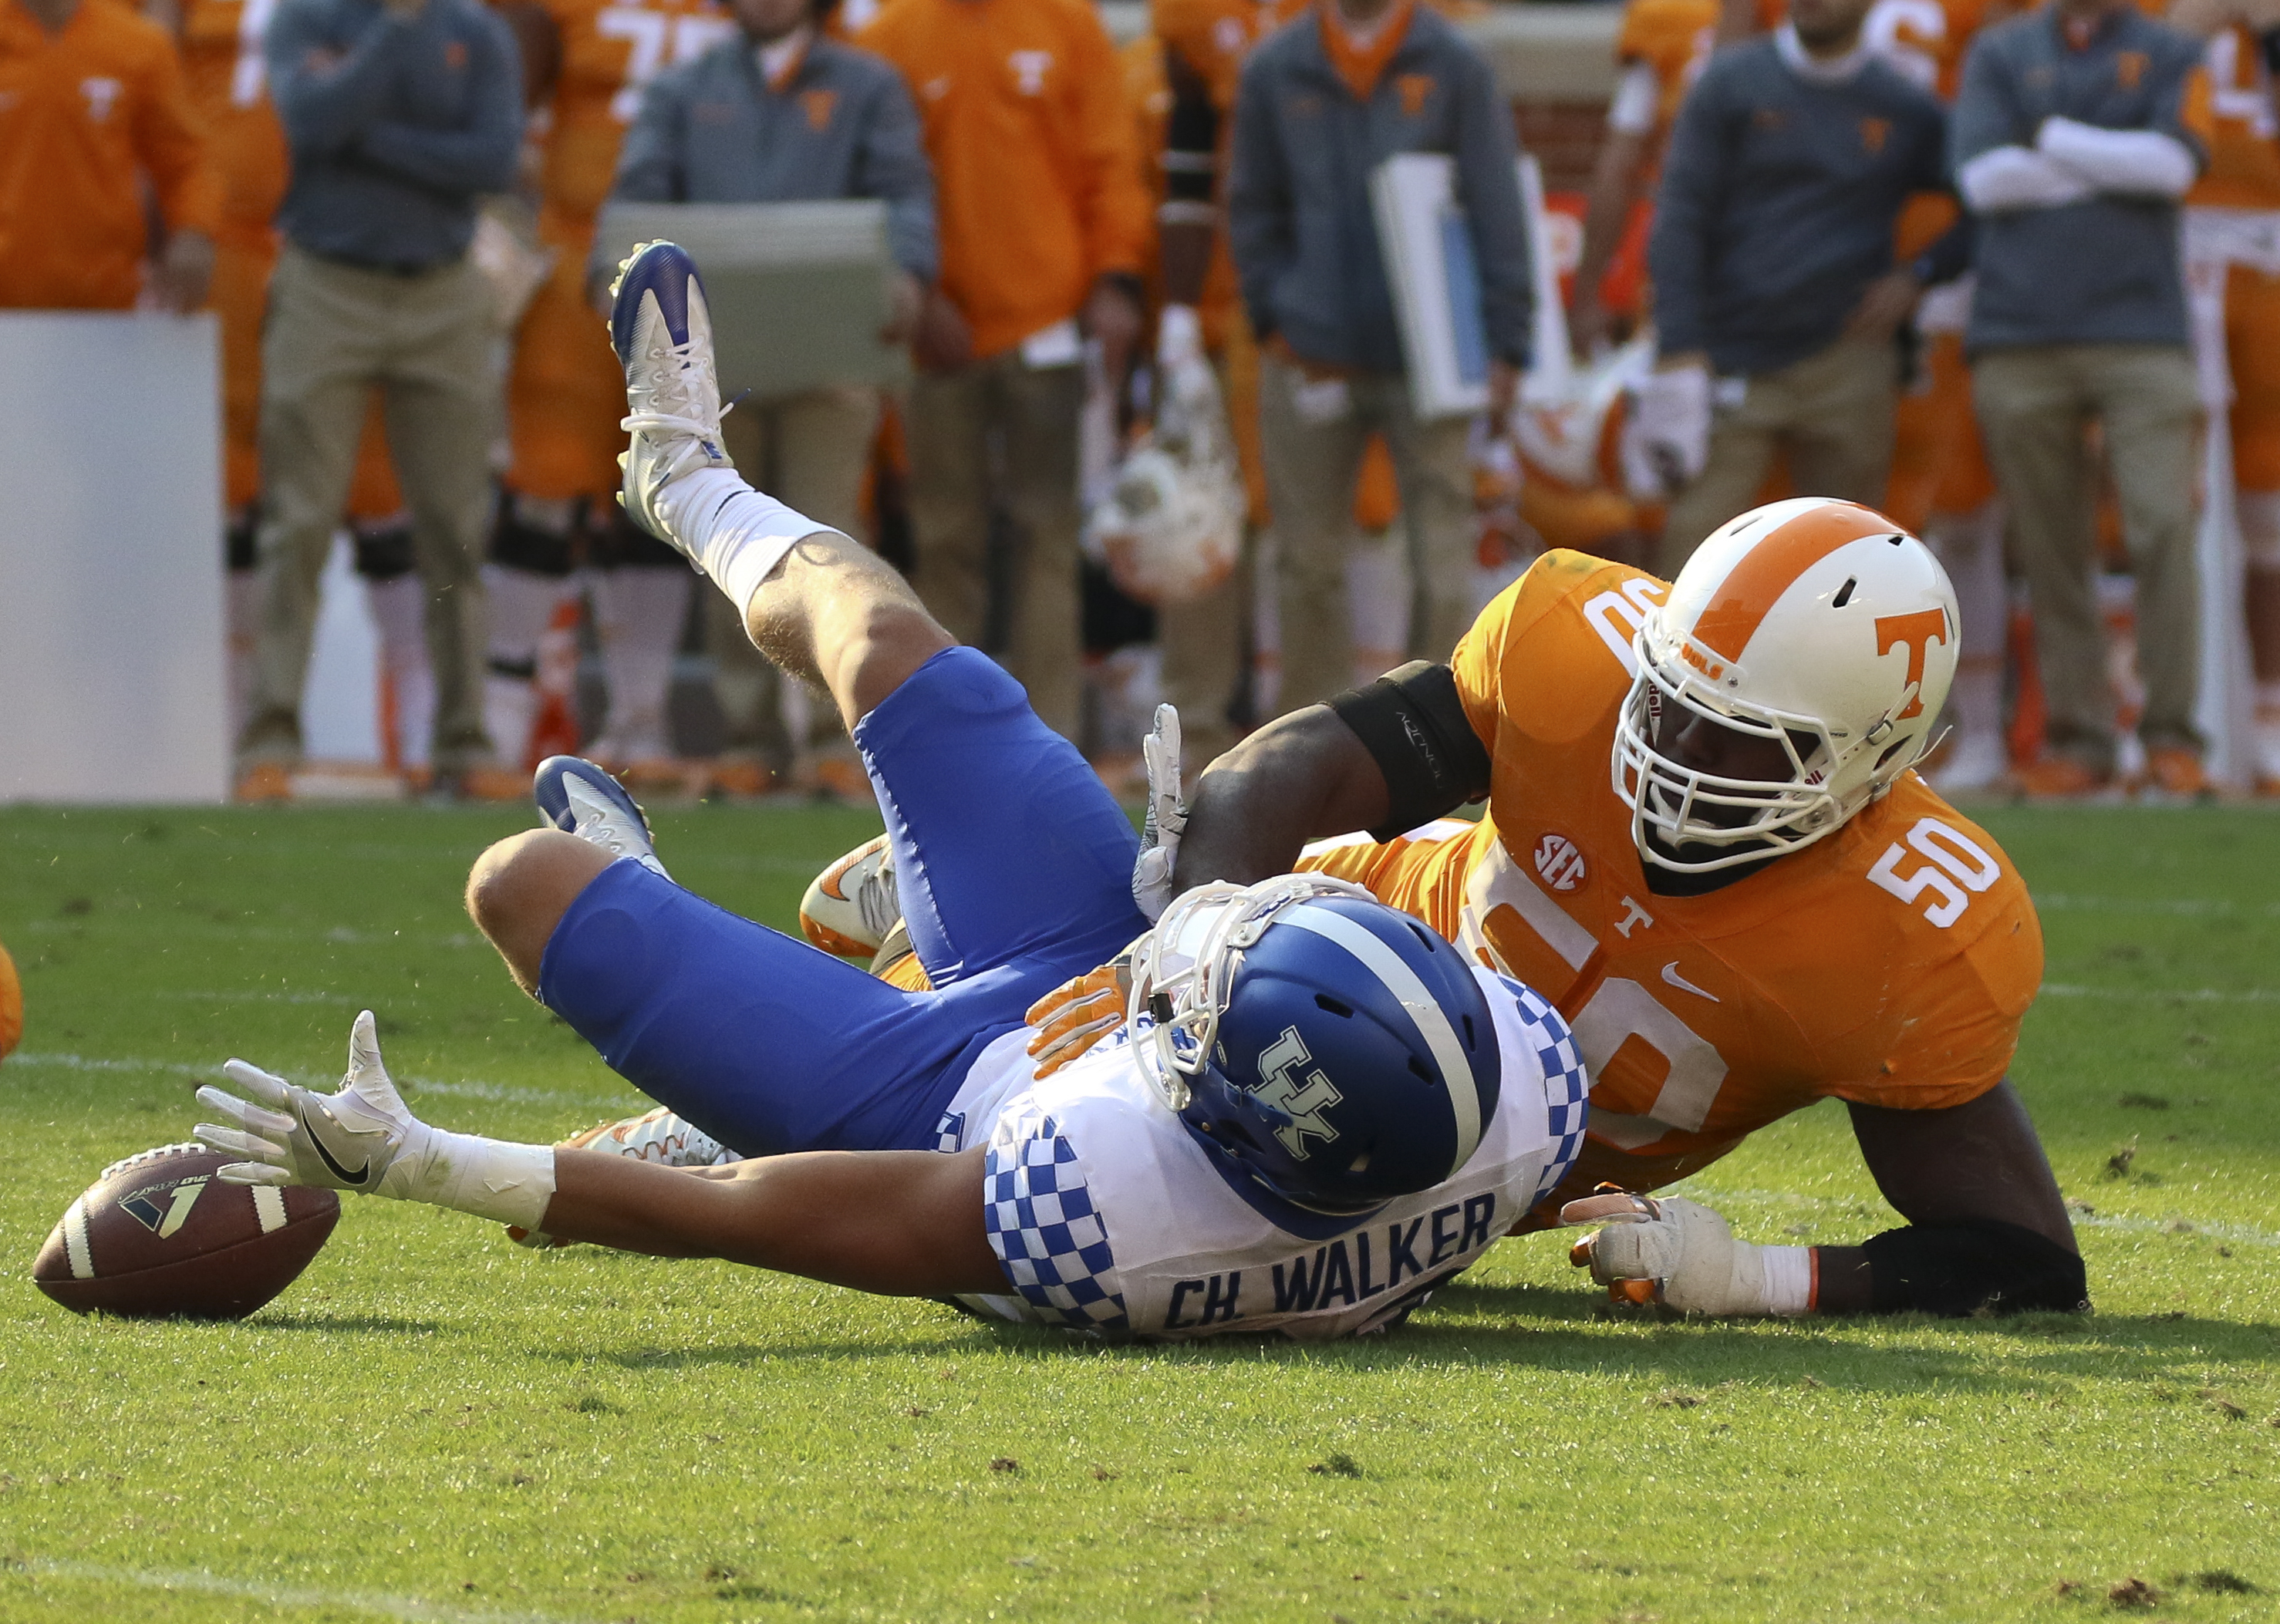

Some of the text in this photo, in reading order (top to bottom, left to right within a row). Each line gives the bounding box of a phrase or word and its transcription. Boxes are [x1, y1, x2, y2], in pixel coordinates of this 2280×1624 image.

[1681, 642, 1725, 680] VOLS
[1534, 834, 1586, 891] SEC
[1866, 817, 2002, 928] 50
[1614, 895, 1654, 938] T
[1243, 1024, 1344, 1161] UK
[1163, 1192, 1496, 1329] CH. WALKER
